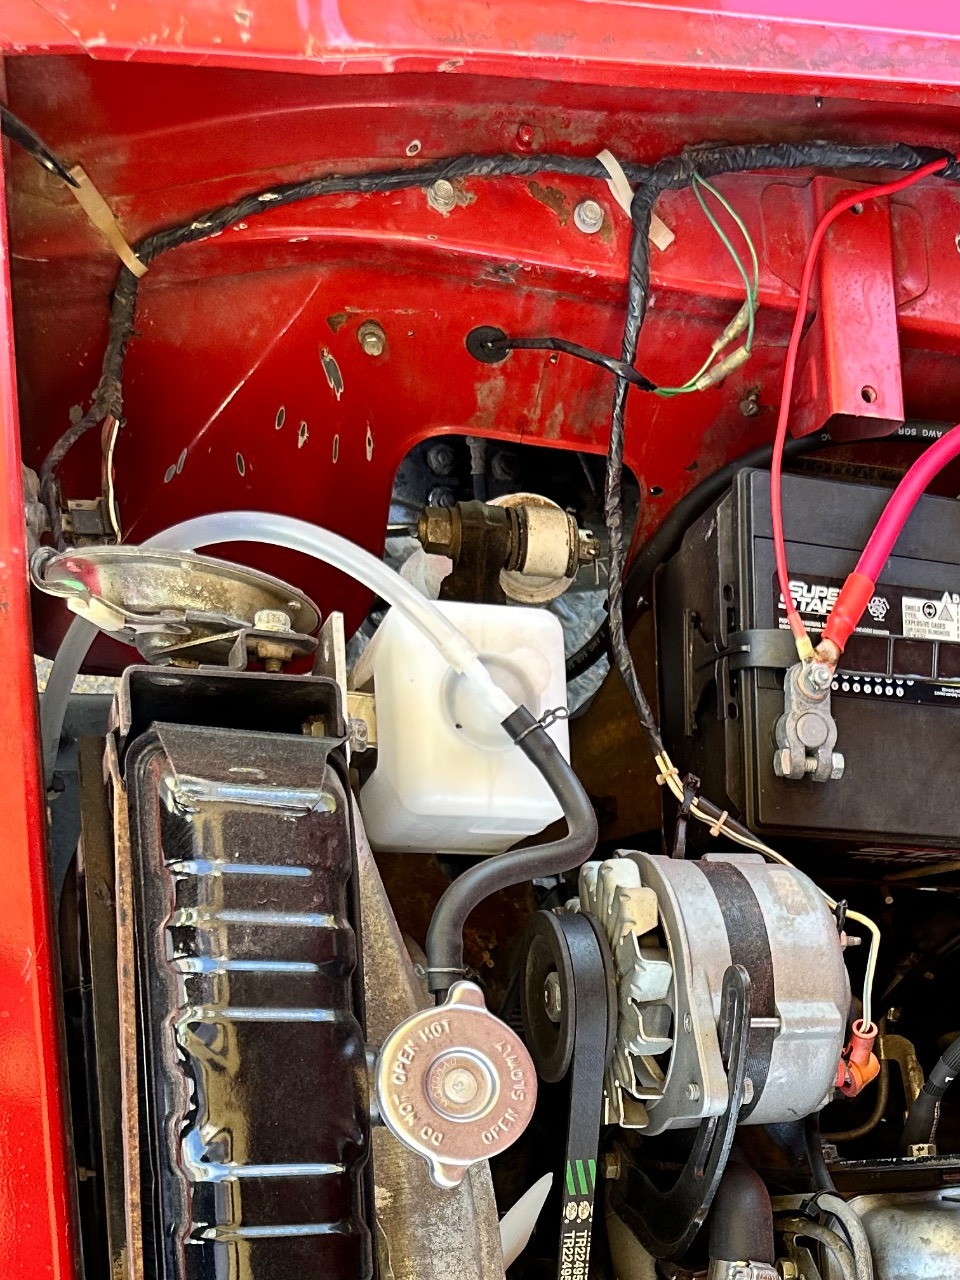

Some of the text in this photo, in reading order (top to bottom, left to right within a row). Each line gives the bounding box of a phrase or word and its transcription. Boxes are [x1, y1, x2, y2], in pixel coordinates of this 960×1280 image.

[898, 427, 942, 438] AWG SGR
[788, 580, 843, 601] SUPE
[778, 594, 836, 613] STA
[904, 619, 946, 630] EXPLOSIVE GASES
[391, 1019, 451, 1146] DO NOT OPEN HOT
[481, 1107, 519, 1145] OPEN
